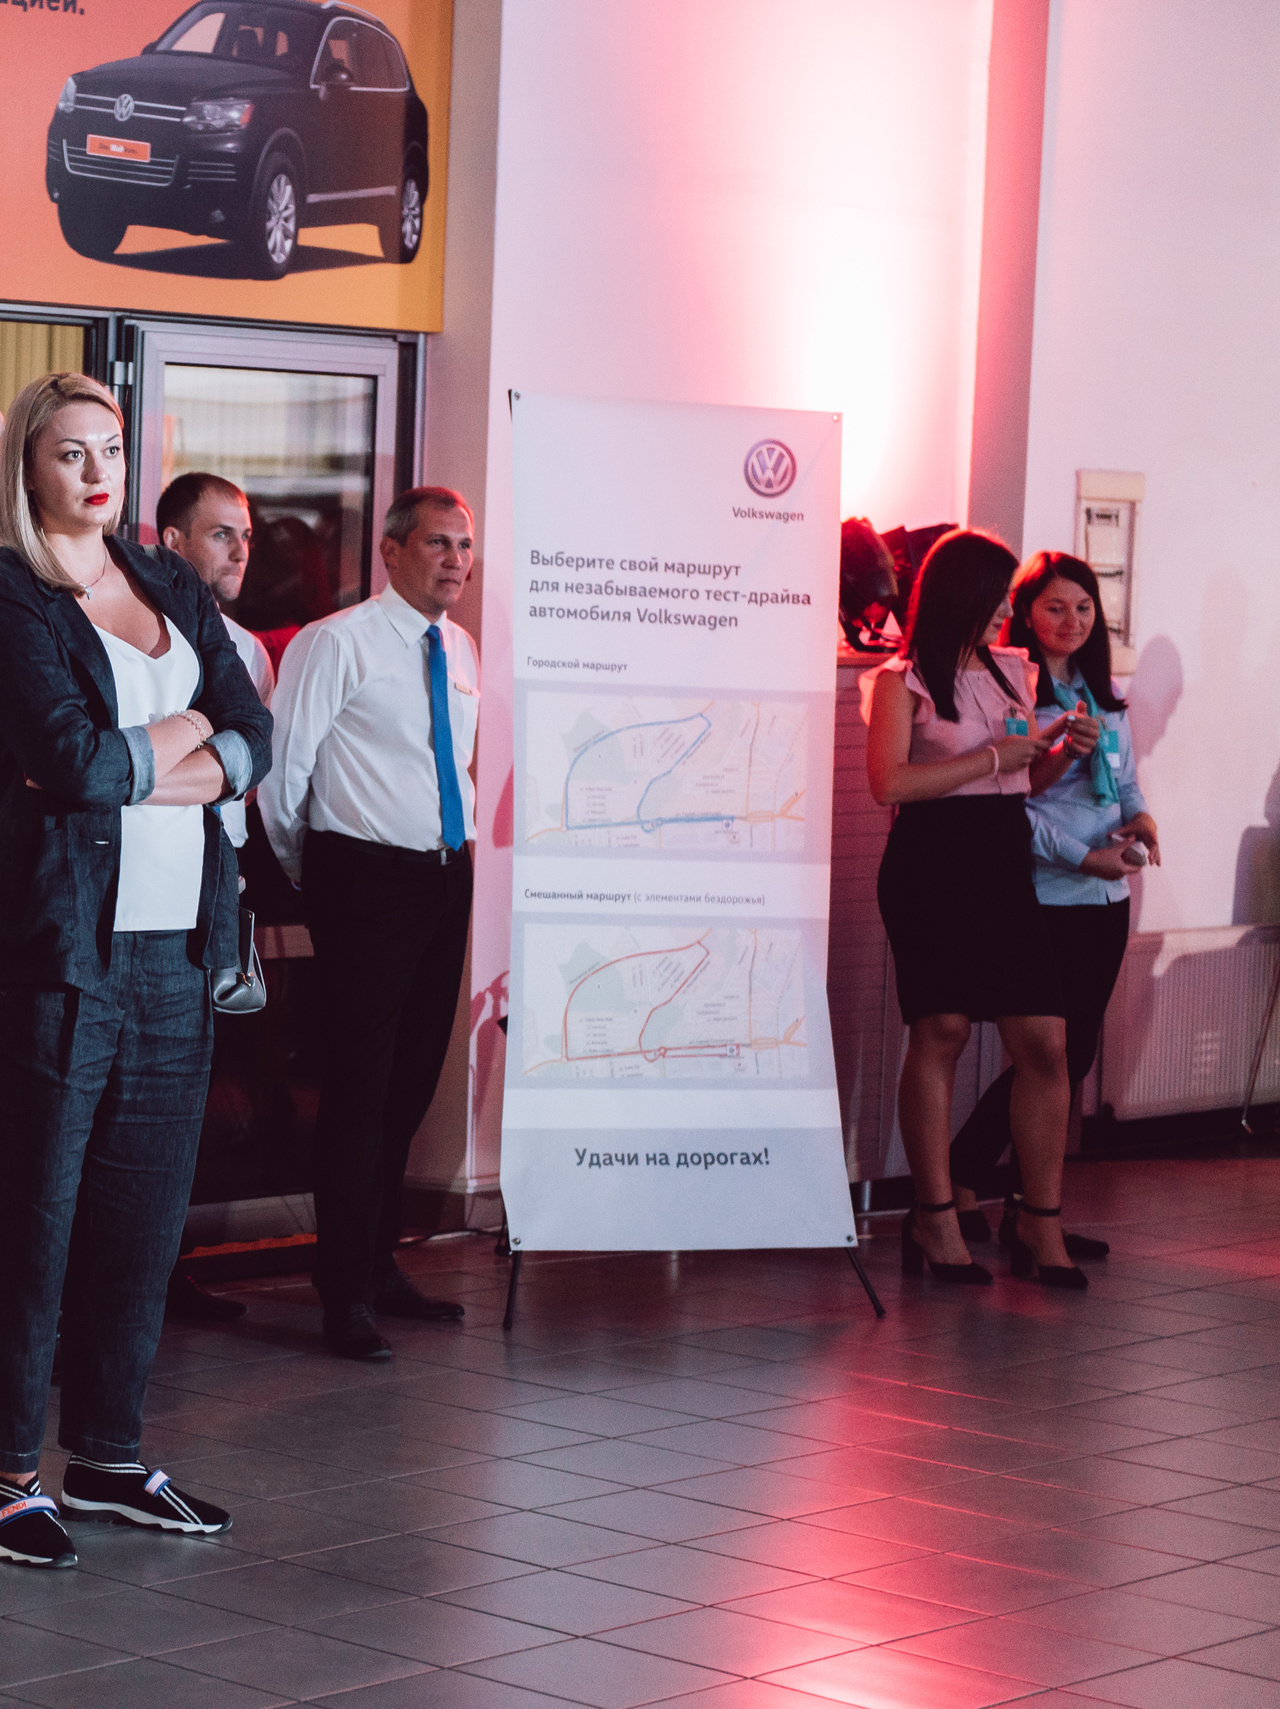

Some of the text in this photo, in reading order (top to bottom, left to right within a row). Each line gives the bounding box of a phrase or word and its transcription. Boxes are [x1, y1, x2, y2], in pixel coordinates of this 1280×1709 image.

[732, 507, 804, 523] Volkswagen
[530, 550, 741, 580] Выберите свой маршрут
[529, 580, 812, 607] для незабываемого тест-драйва
[529, 604, 738, 631] автомобиля Volkswagen
[527, 656, 628, 673] Городской маршрут
[524, 888, 584, 900] Смешанный
[586, 893, 632, 903] маршрут
[644, 895, 702, 903] элементами
[704, 892, 766, 906] бездорожья)
[574, 1148, 771, 1170] Удачи на дорогах!
[1, 1500, 27, 1518] FENDI
